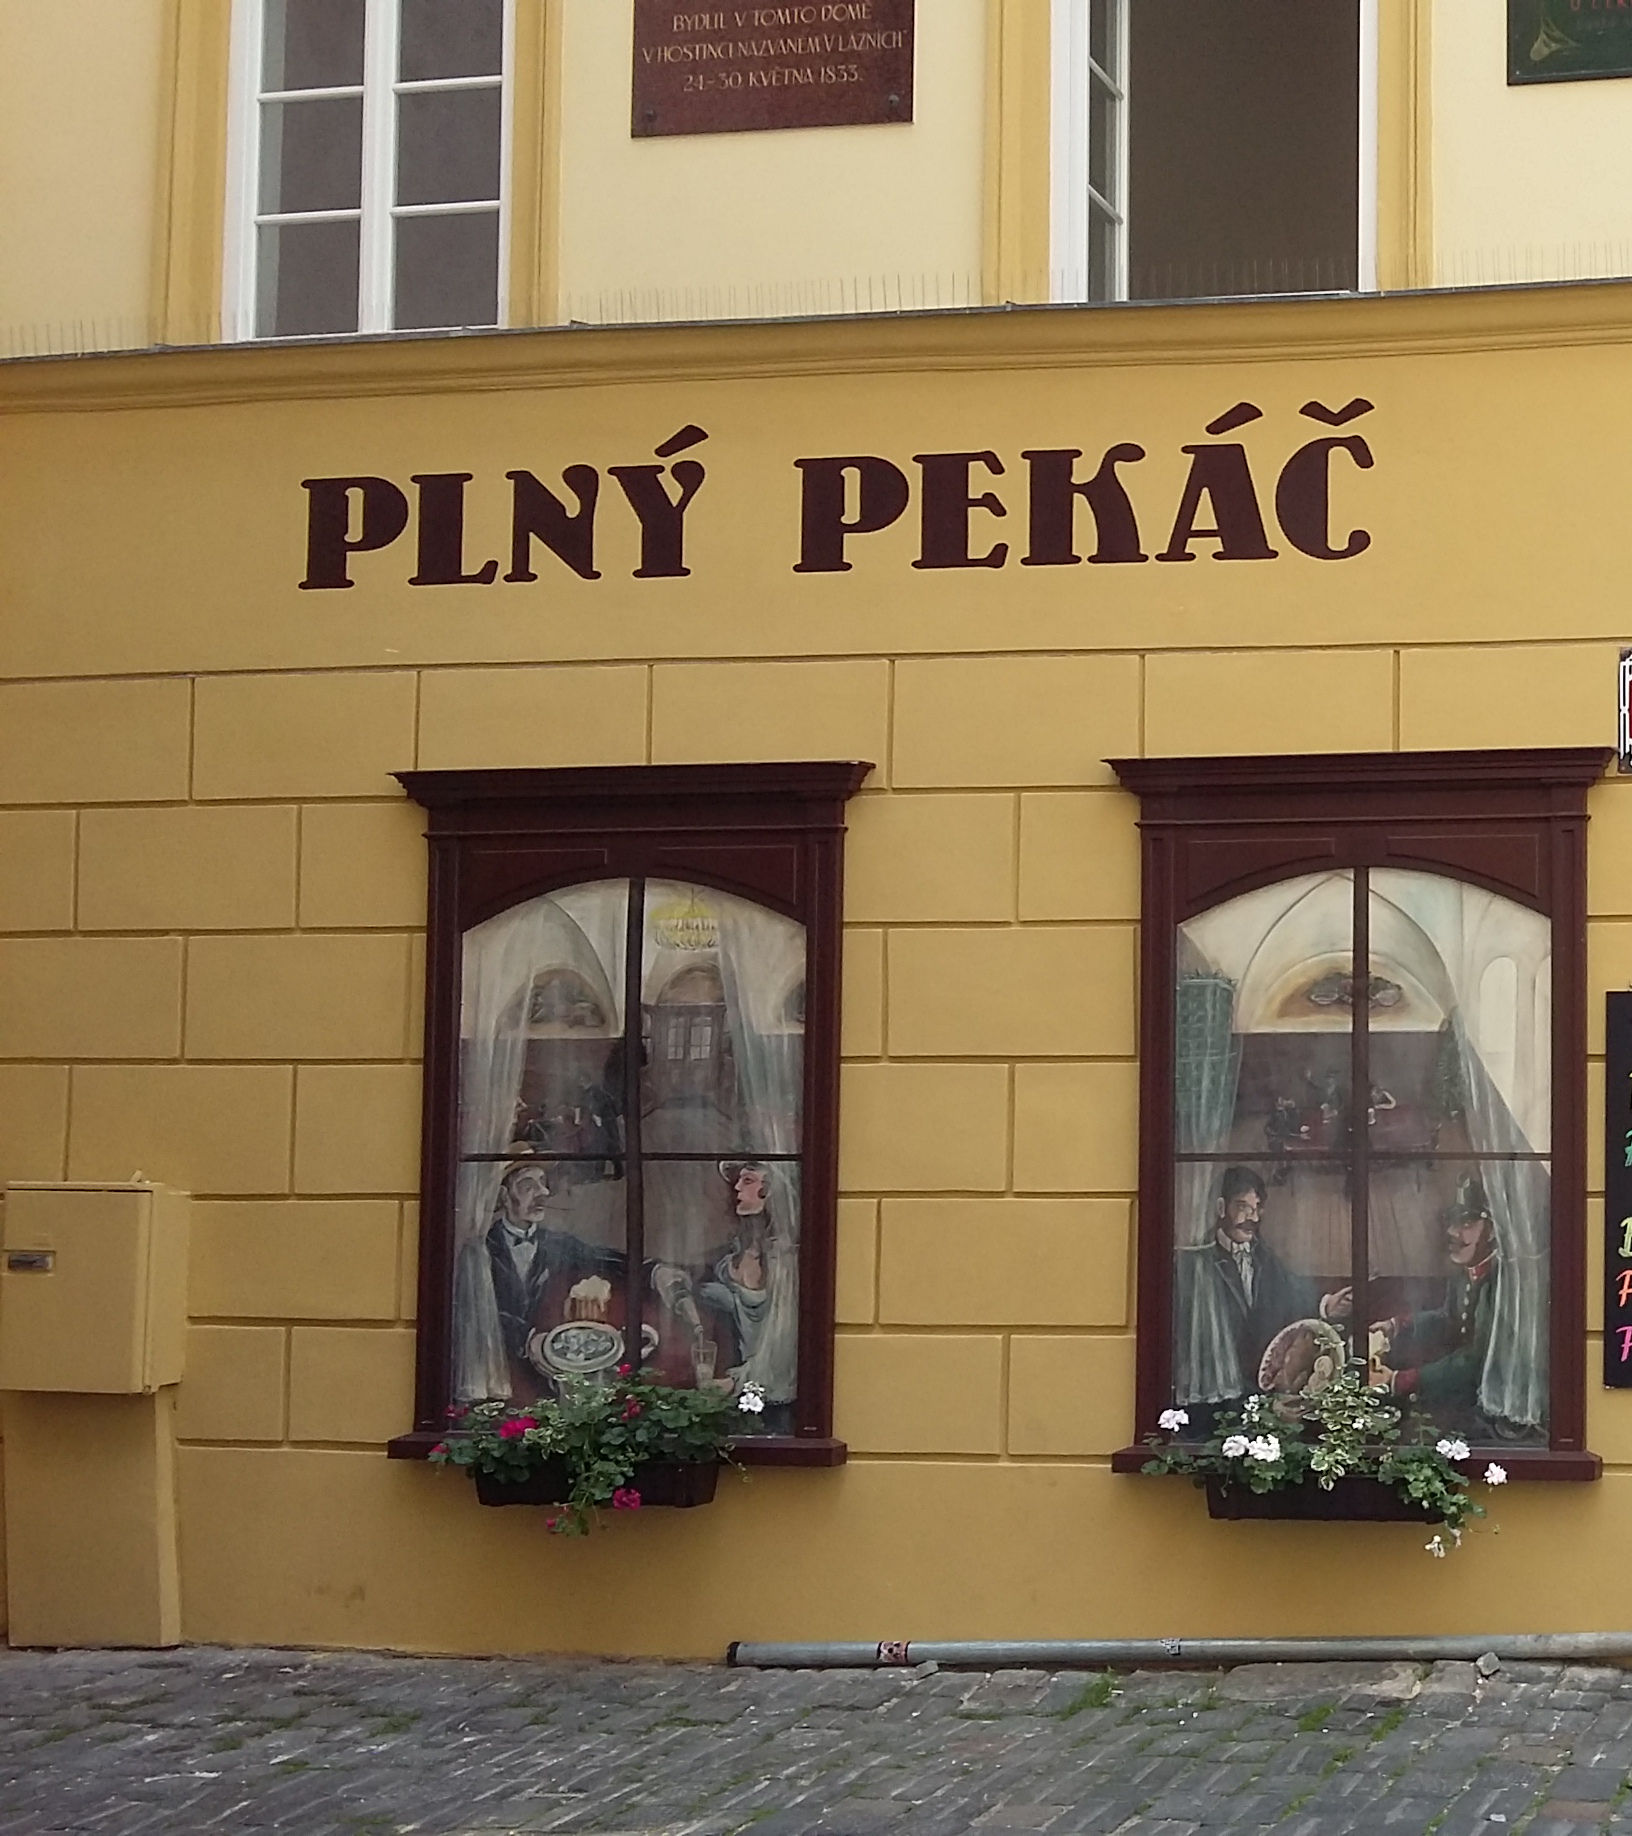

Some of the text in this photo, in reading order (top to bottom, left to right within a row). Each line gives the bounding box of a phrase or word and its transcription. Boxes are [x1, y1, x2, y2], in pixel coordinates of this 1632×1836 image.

[734, 12, 747, 27] V
[753, 6, 817, 26] TOMTO
[642, 46, 654, 64] V
[656, 42, 733, 63] HOSTINCI
[823, 33, 836, 52] V
[299, 397, 1374, 591] PLNÝ PEKÁČ
